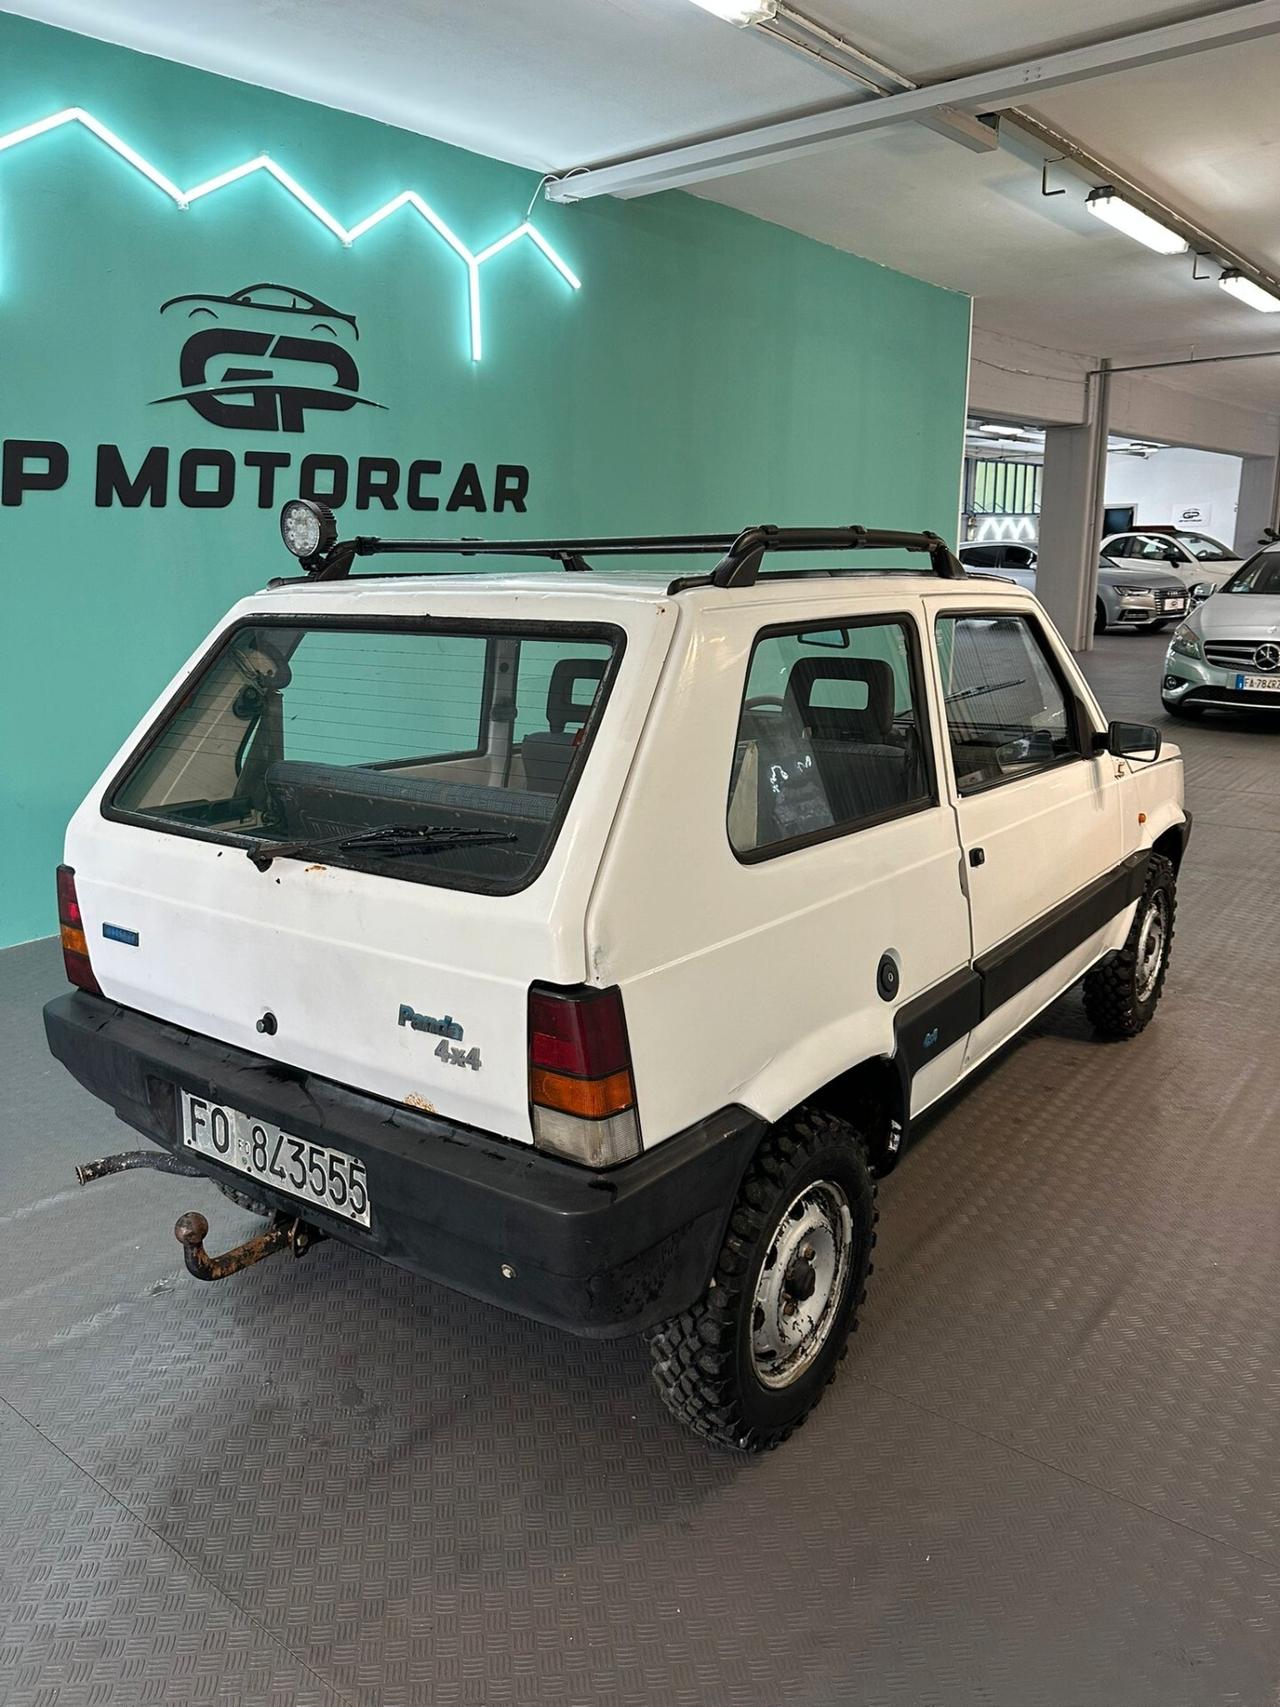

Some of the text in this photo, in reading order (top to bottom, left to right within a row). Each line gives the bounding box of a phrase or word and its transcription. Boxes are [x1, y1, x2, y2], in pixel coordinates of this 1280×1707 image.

[180, 327, 360, 433] GP
[95, 444, 530, 513] MOTORCAR
[398, 1003, 464, 1041] Panda
[434, 1038, 482, 1071] 4x4
[190, 1097, 229, 1153] FO
[252, 1125, 366, 1214] 843555
